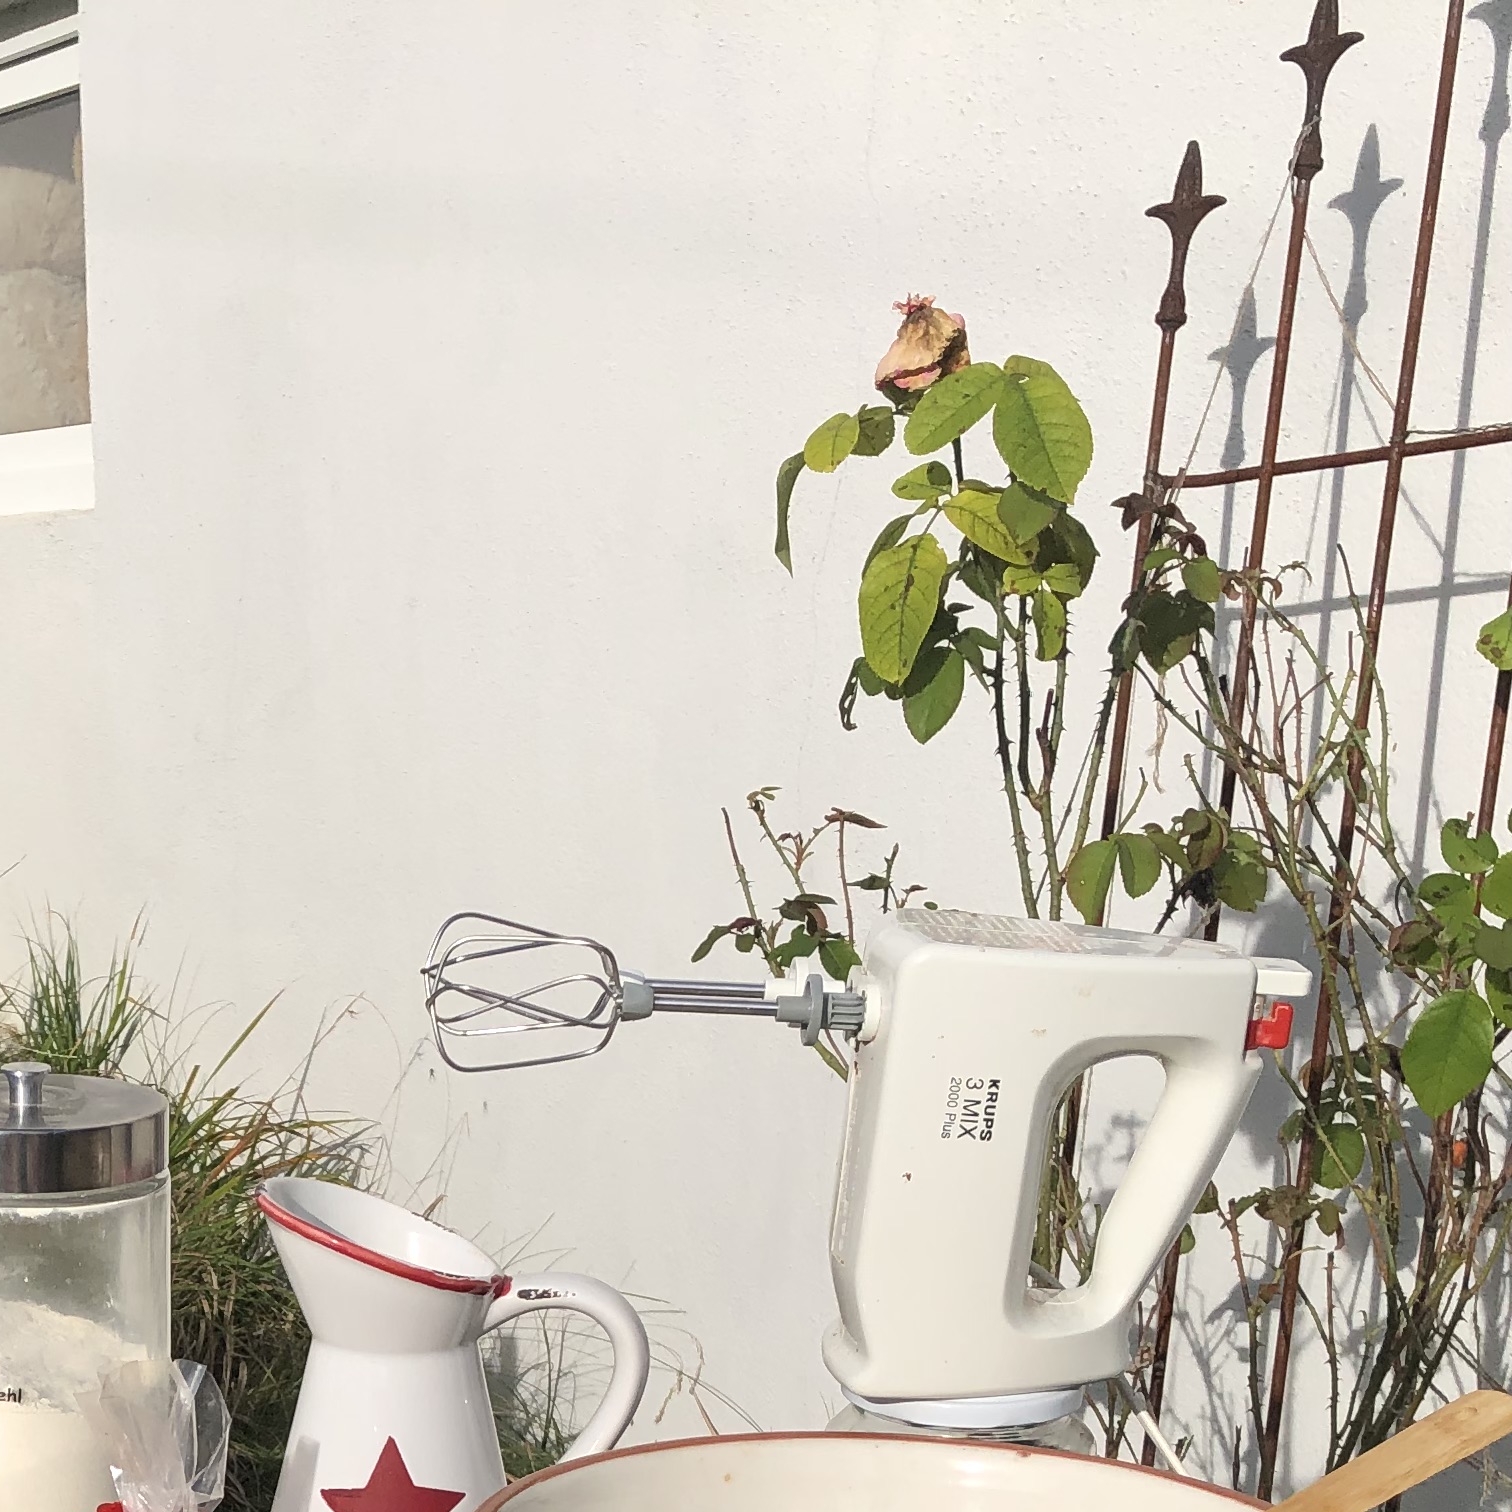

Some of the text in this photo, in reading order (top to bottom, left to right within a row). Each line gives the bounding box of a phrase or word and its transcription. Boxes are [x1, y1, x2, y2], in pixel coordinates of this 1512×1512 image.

[941, 1077, 962, 1139] 2000 Plus
[957, 1078, 984, 1140] 3 MIX
[980, 1079, 1001, 1141] KRUPS
